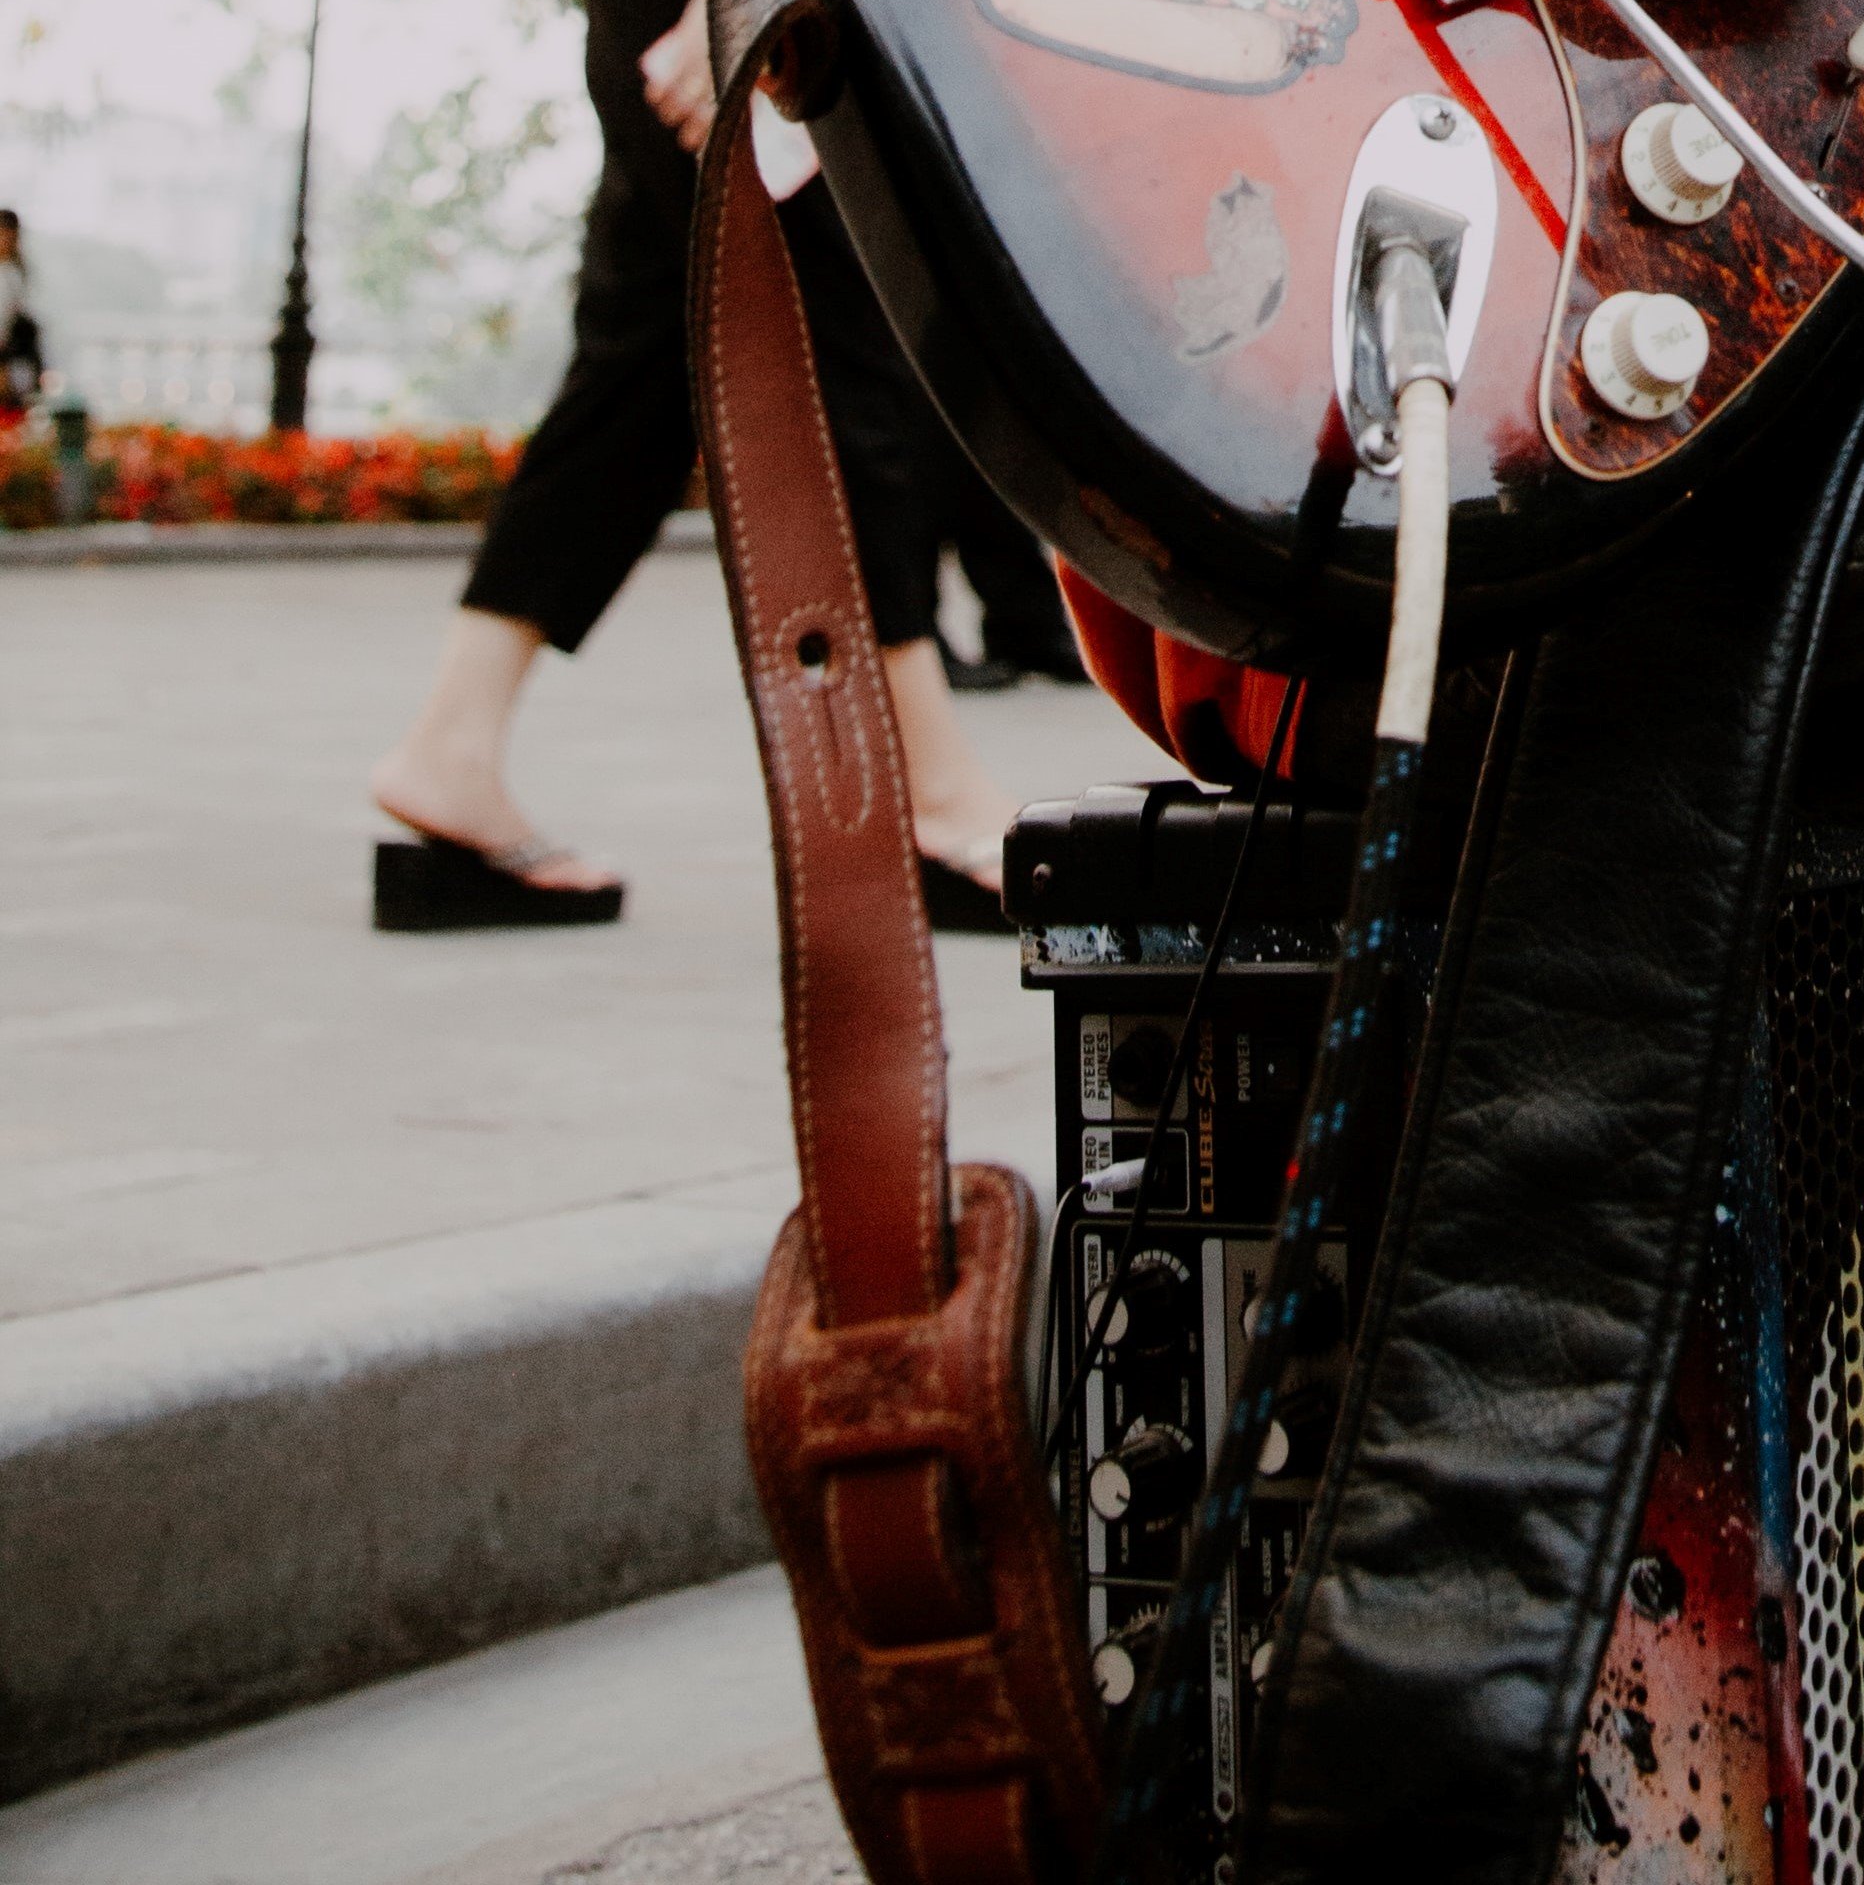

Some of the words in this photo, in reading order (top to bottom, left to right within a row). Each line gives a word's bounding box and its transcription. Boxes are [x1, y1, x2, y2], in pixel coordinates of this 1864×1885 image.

[1083, 1033, 1096, 1099] STEREO
[1096, 1032, 1110, 1101] PHONES
[1236, 1032, 1251, 1103] POWER
[1199, 1105, 1215, 1215] CUBE
[1087, 1243, 1099, 1290] EVERB
